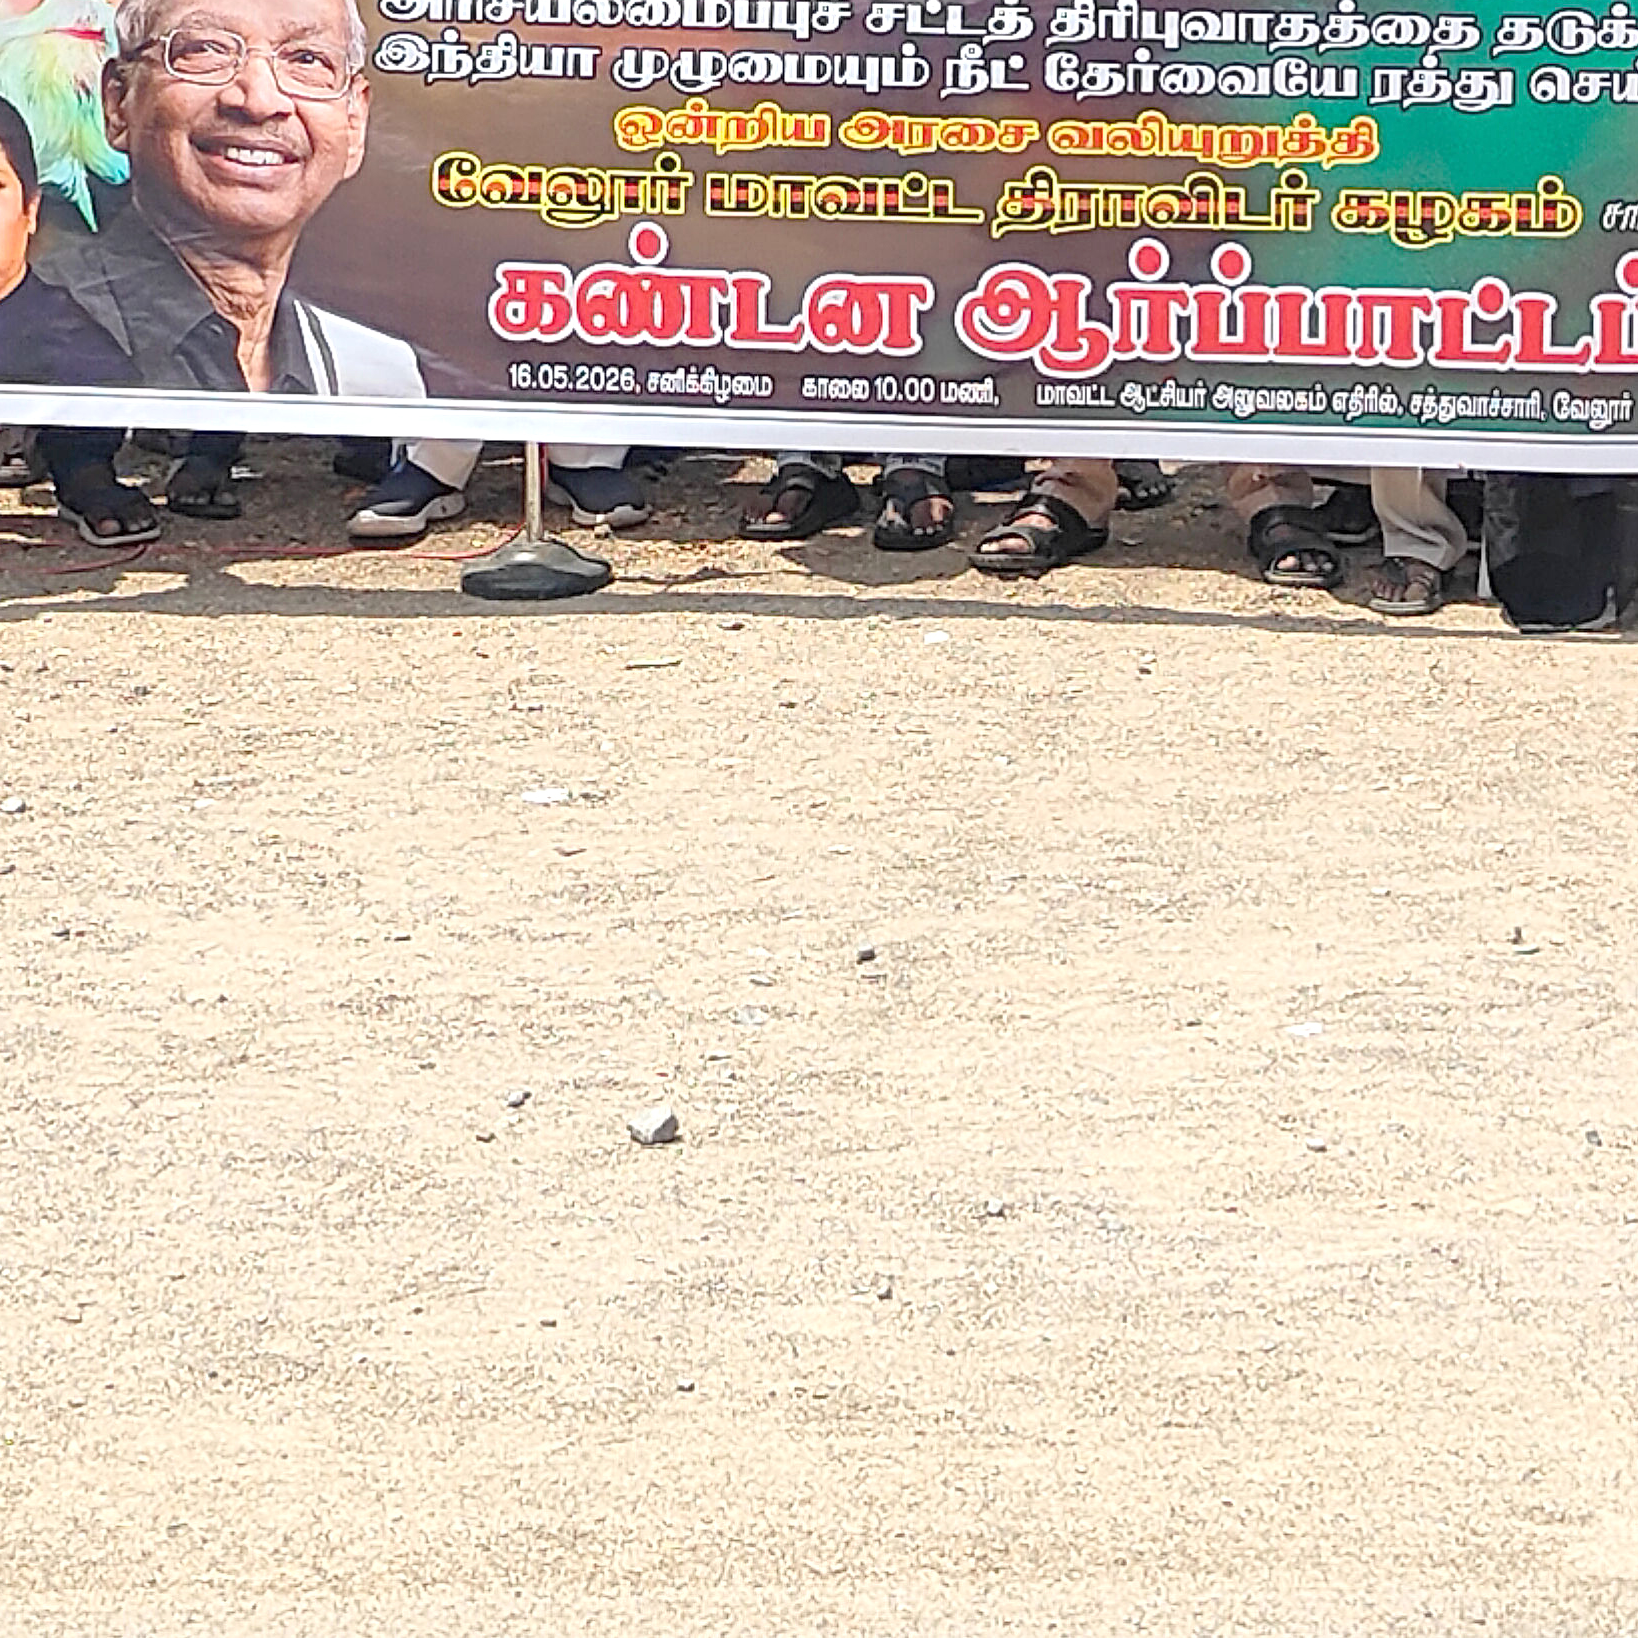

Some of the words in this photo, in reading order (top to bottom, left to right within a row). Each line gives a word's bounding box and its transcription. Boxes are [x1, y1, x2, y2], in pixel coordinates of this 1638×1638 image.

[374, 29, 601, 87] இந்தியா
[611, 41, 929, 95] முழுமையும்
[940, 42, 1030, 99] நீட்
[1043, 46, 1357, 101] தேர்வையே
[1369, 54, 1514, 108] ரத்து
[839, 110, 1040, 156] அரசை
[1047, 110, 1380, 167] வலியுறுத்தி
[431, 152, 691, 228] வேலூர்
[704, 172, 984, 223] மாவட்ட
[991, 166, 1320, 239] திராவிடர்
[1331, 174, 1583, 248] கழகம்
[489, 220, 935, 356] கண்டன
[508, 363, 641, 396] 16.05.2026,
[647, 365, 773, 404] சனிக்கிழமை
[801, 376, 869, 400] காலை
[873, 376, 935, 403] 10.00
[940, 377, 1001, 407] மணி,
[1036, 381, 1116, 408] மாவட்ட
[1119, 383, 1209, 415] ஆட்சியர்
[1211, 383, 1327, 417] அலுவலகம்
[1330, 385, 1405, 420] எதிரில்,
[1408, 388, 1547, 424] சத்துவாச்சாரி,
[1551, 395, 1635, 431] வேலூர்
